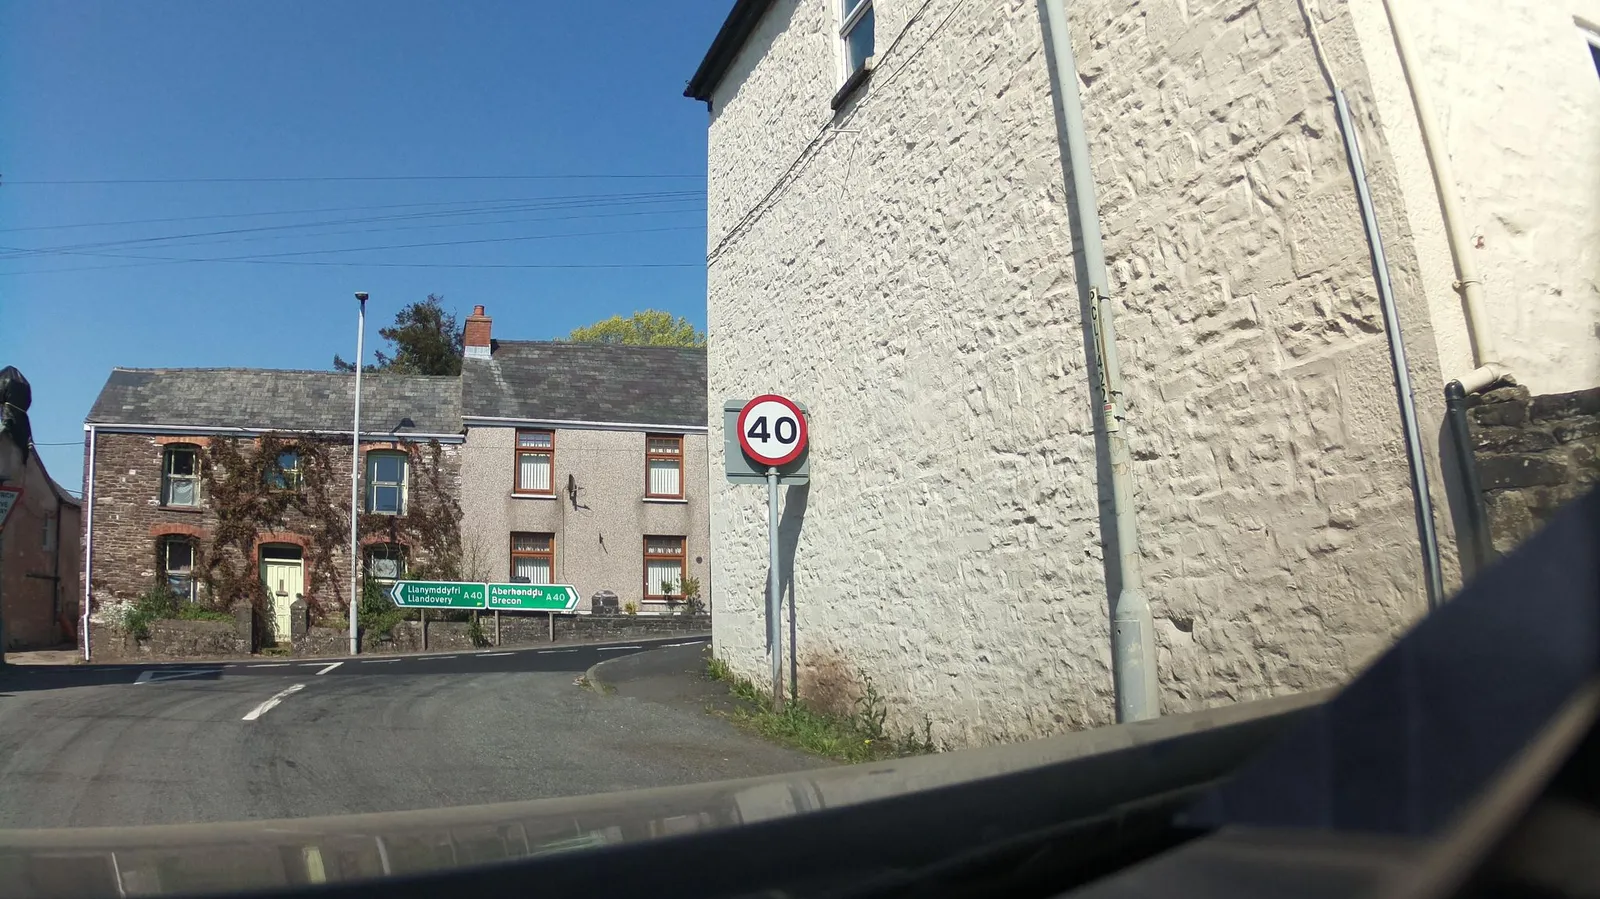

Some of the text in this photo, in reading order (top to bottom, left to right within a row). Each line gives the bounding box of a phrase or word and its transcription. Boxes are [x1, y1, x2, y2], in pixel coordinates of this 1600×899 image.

[747, 416, 797, 444] 40
[407, 585, 461, 595] Llanymddyfri
[407, 594, 453, 605] Llandovery
[491, 596, 522, 605] Brecon
